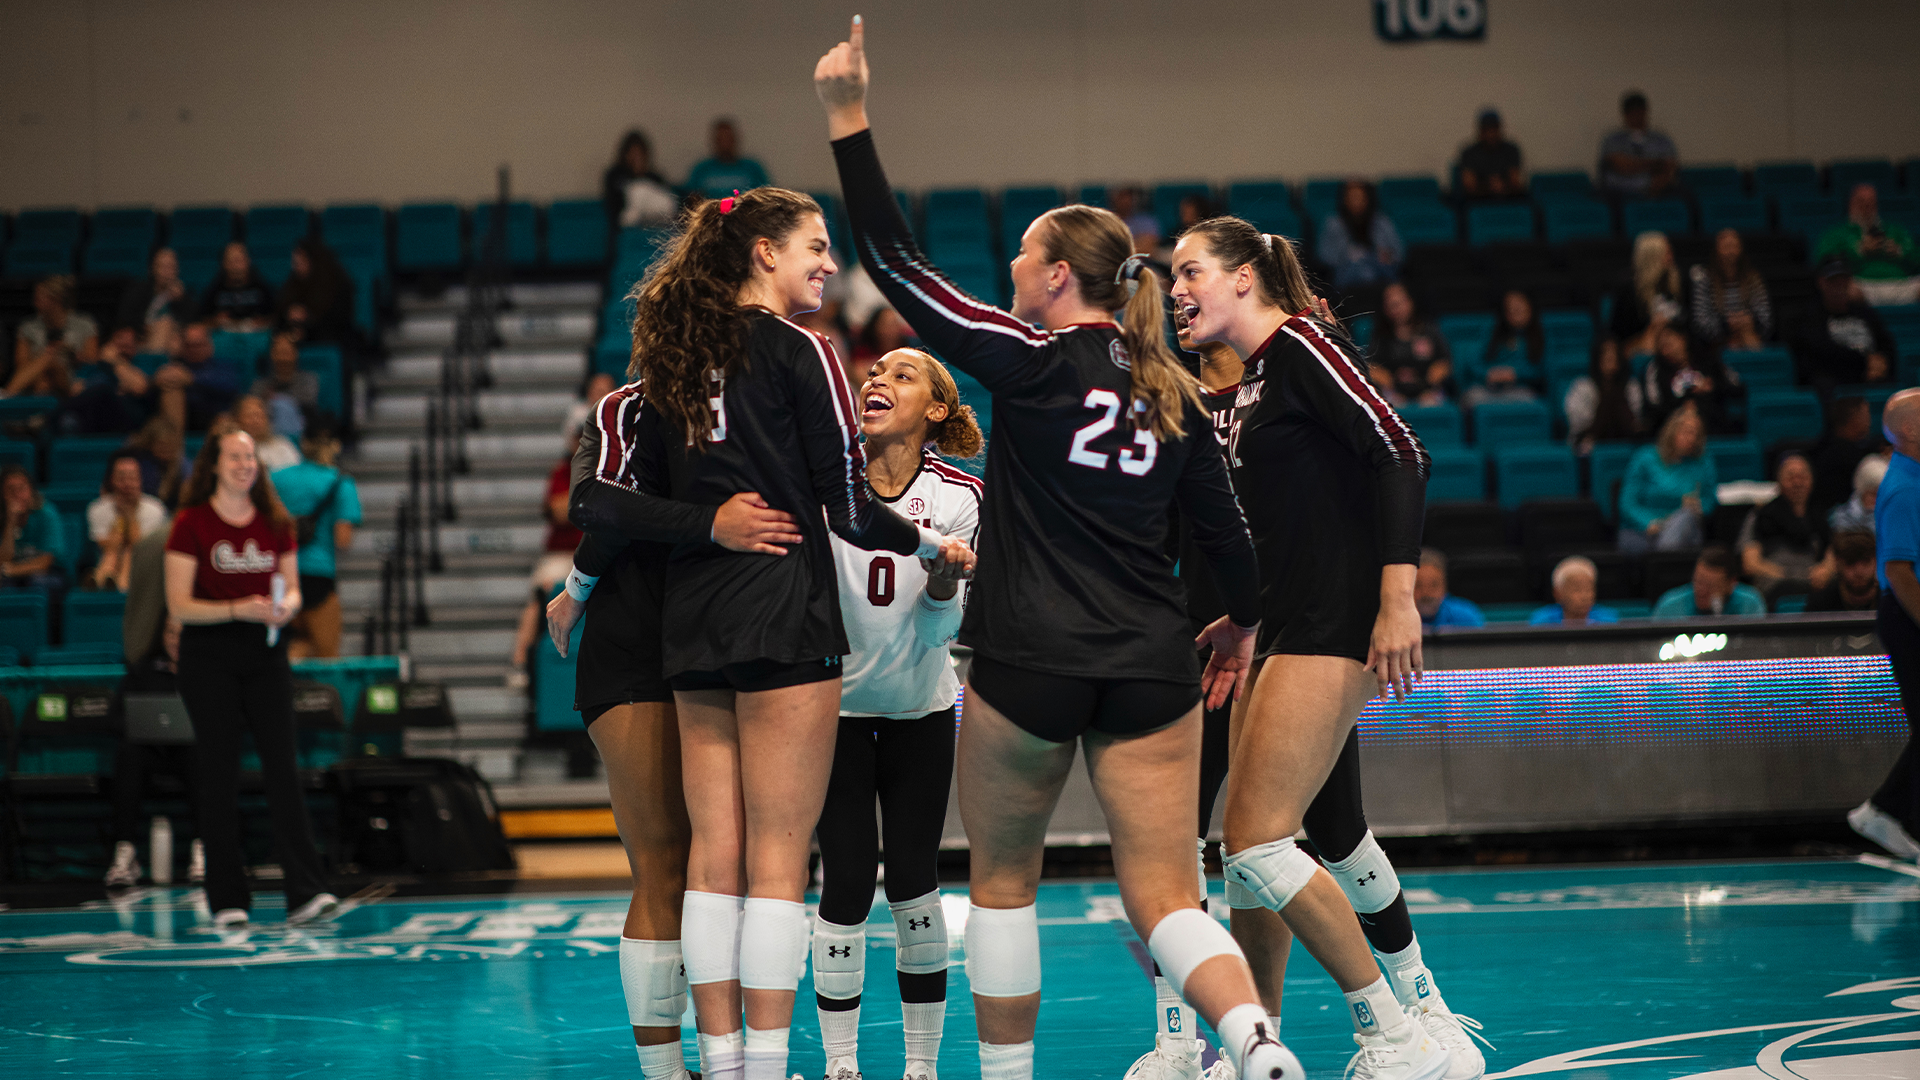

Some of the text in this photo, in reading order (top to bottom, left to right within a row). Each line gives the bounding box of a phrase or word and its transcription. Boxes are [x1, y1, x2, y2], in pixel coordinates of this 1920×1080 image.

[1384, 0, 1480, 34] 106
[1068, 389, 1158, 476] 23
[907, 498, 925, 516] SEC
[867, 555, 896, 607] 0
